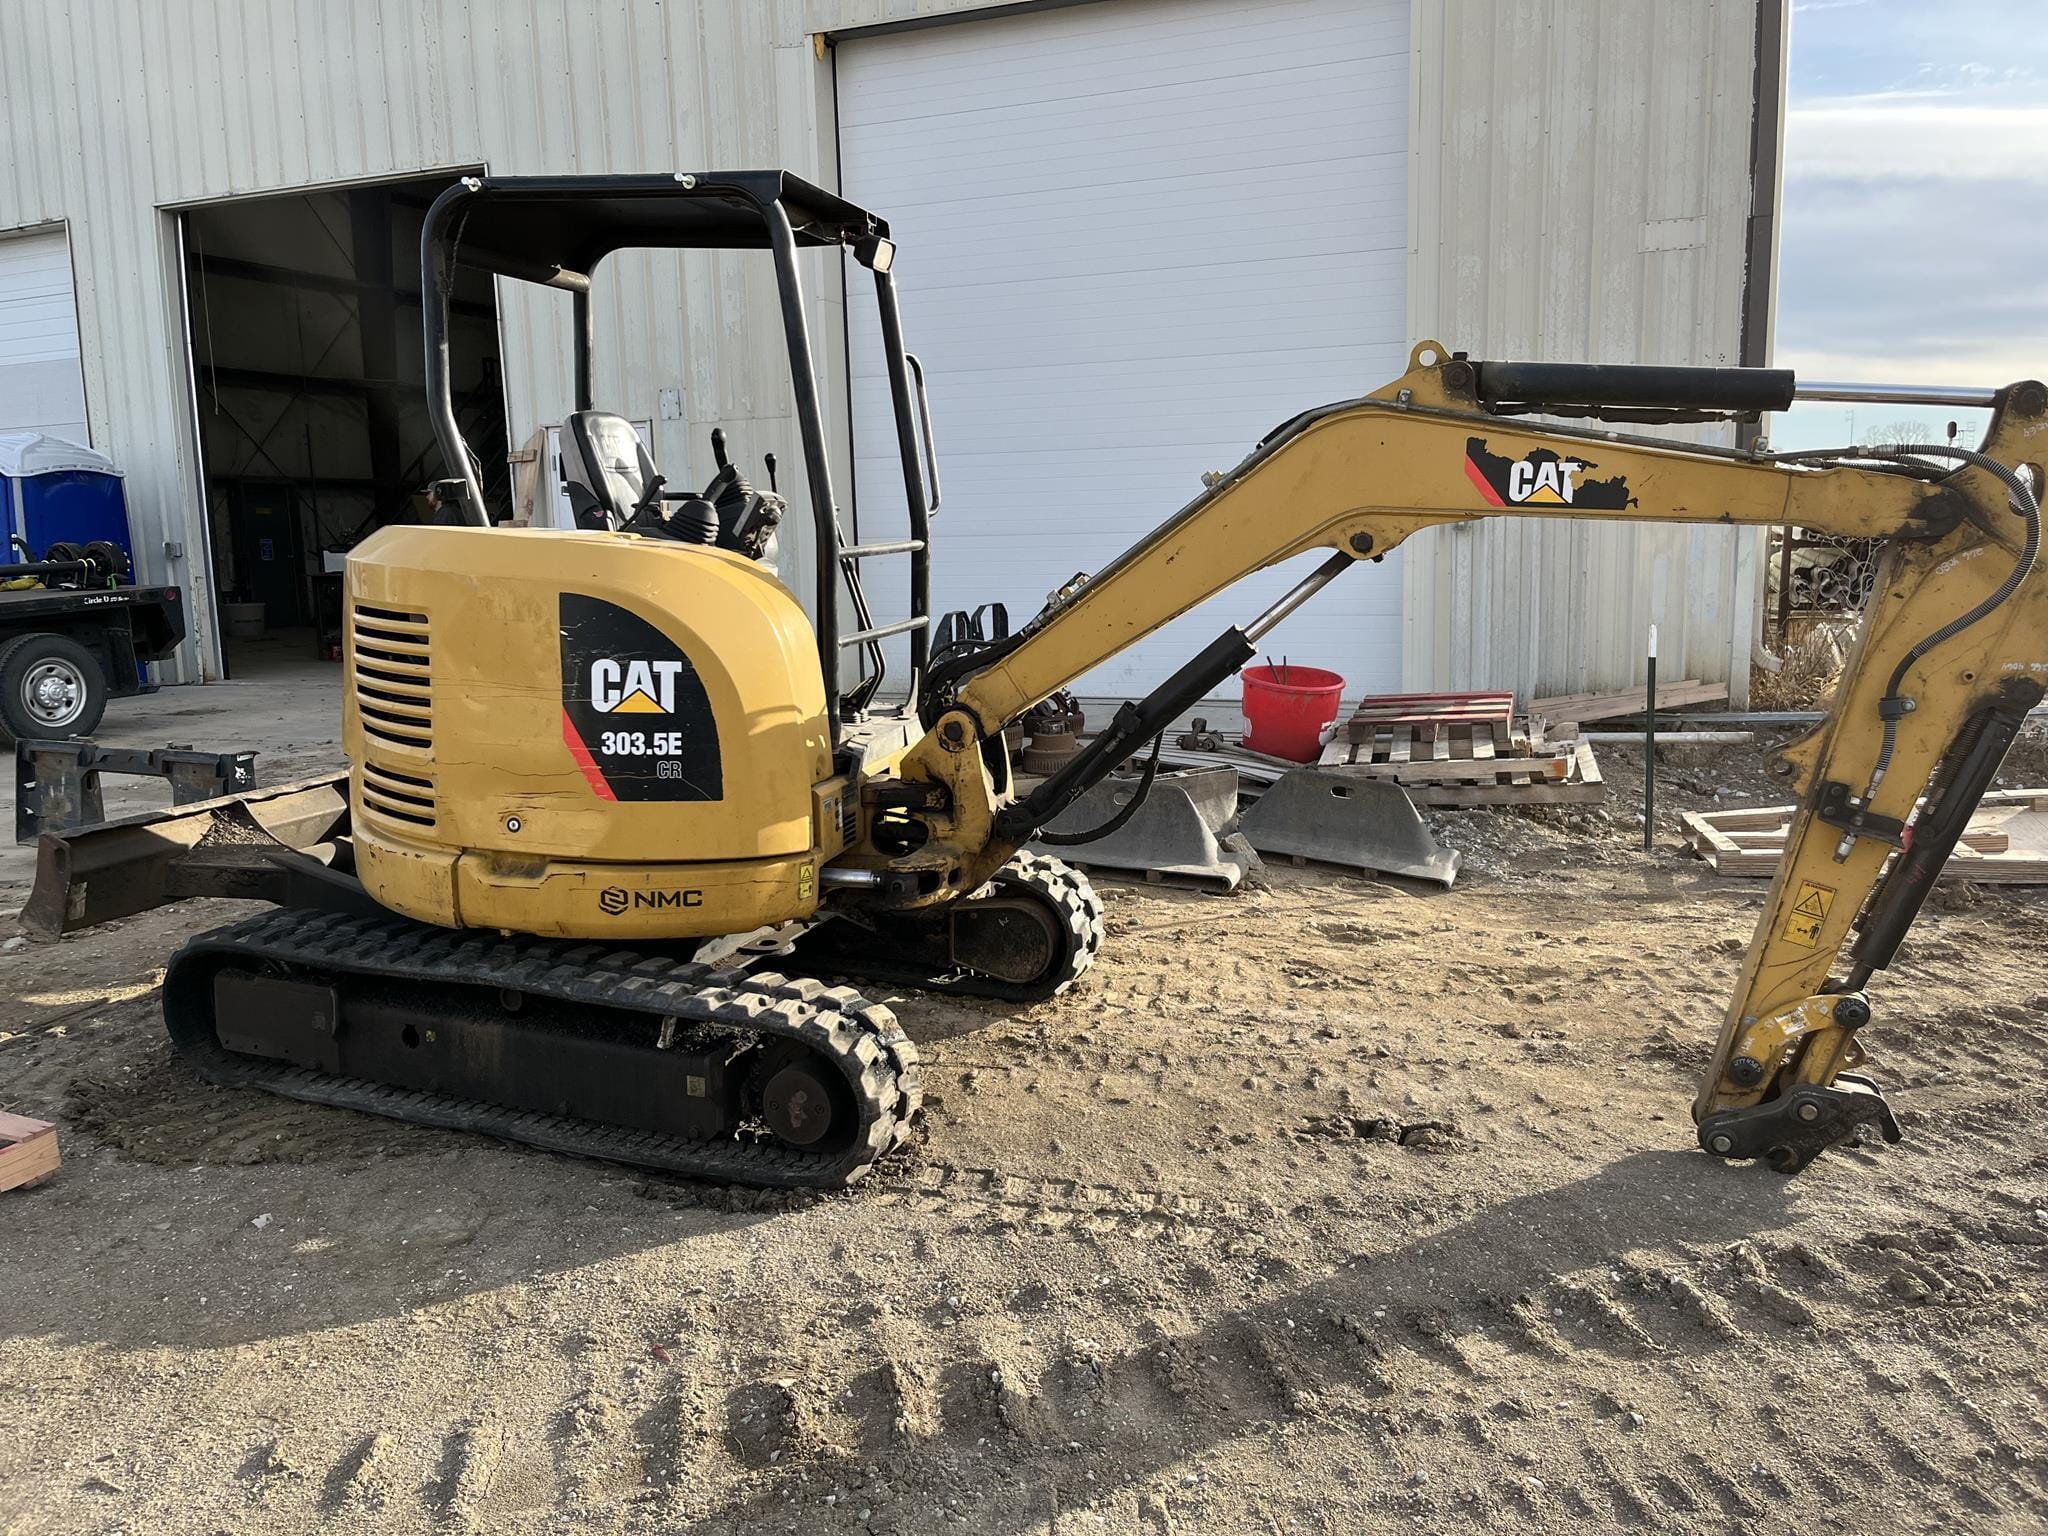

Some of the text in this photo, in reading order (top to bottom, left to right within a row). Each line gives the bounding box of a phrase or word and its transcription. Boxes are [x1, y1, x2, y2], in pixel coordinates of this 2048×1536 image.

[1508, 461, 1582, 504] CAT
[591, 658, 683, 714] CAT
[601, 731, 683, 756] 303.5E
[656, 760, 683, 780] CR
[634, 890, 703, 909] NMC
